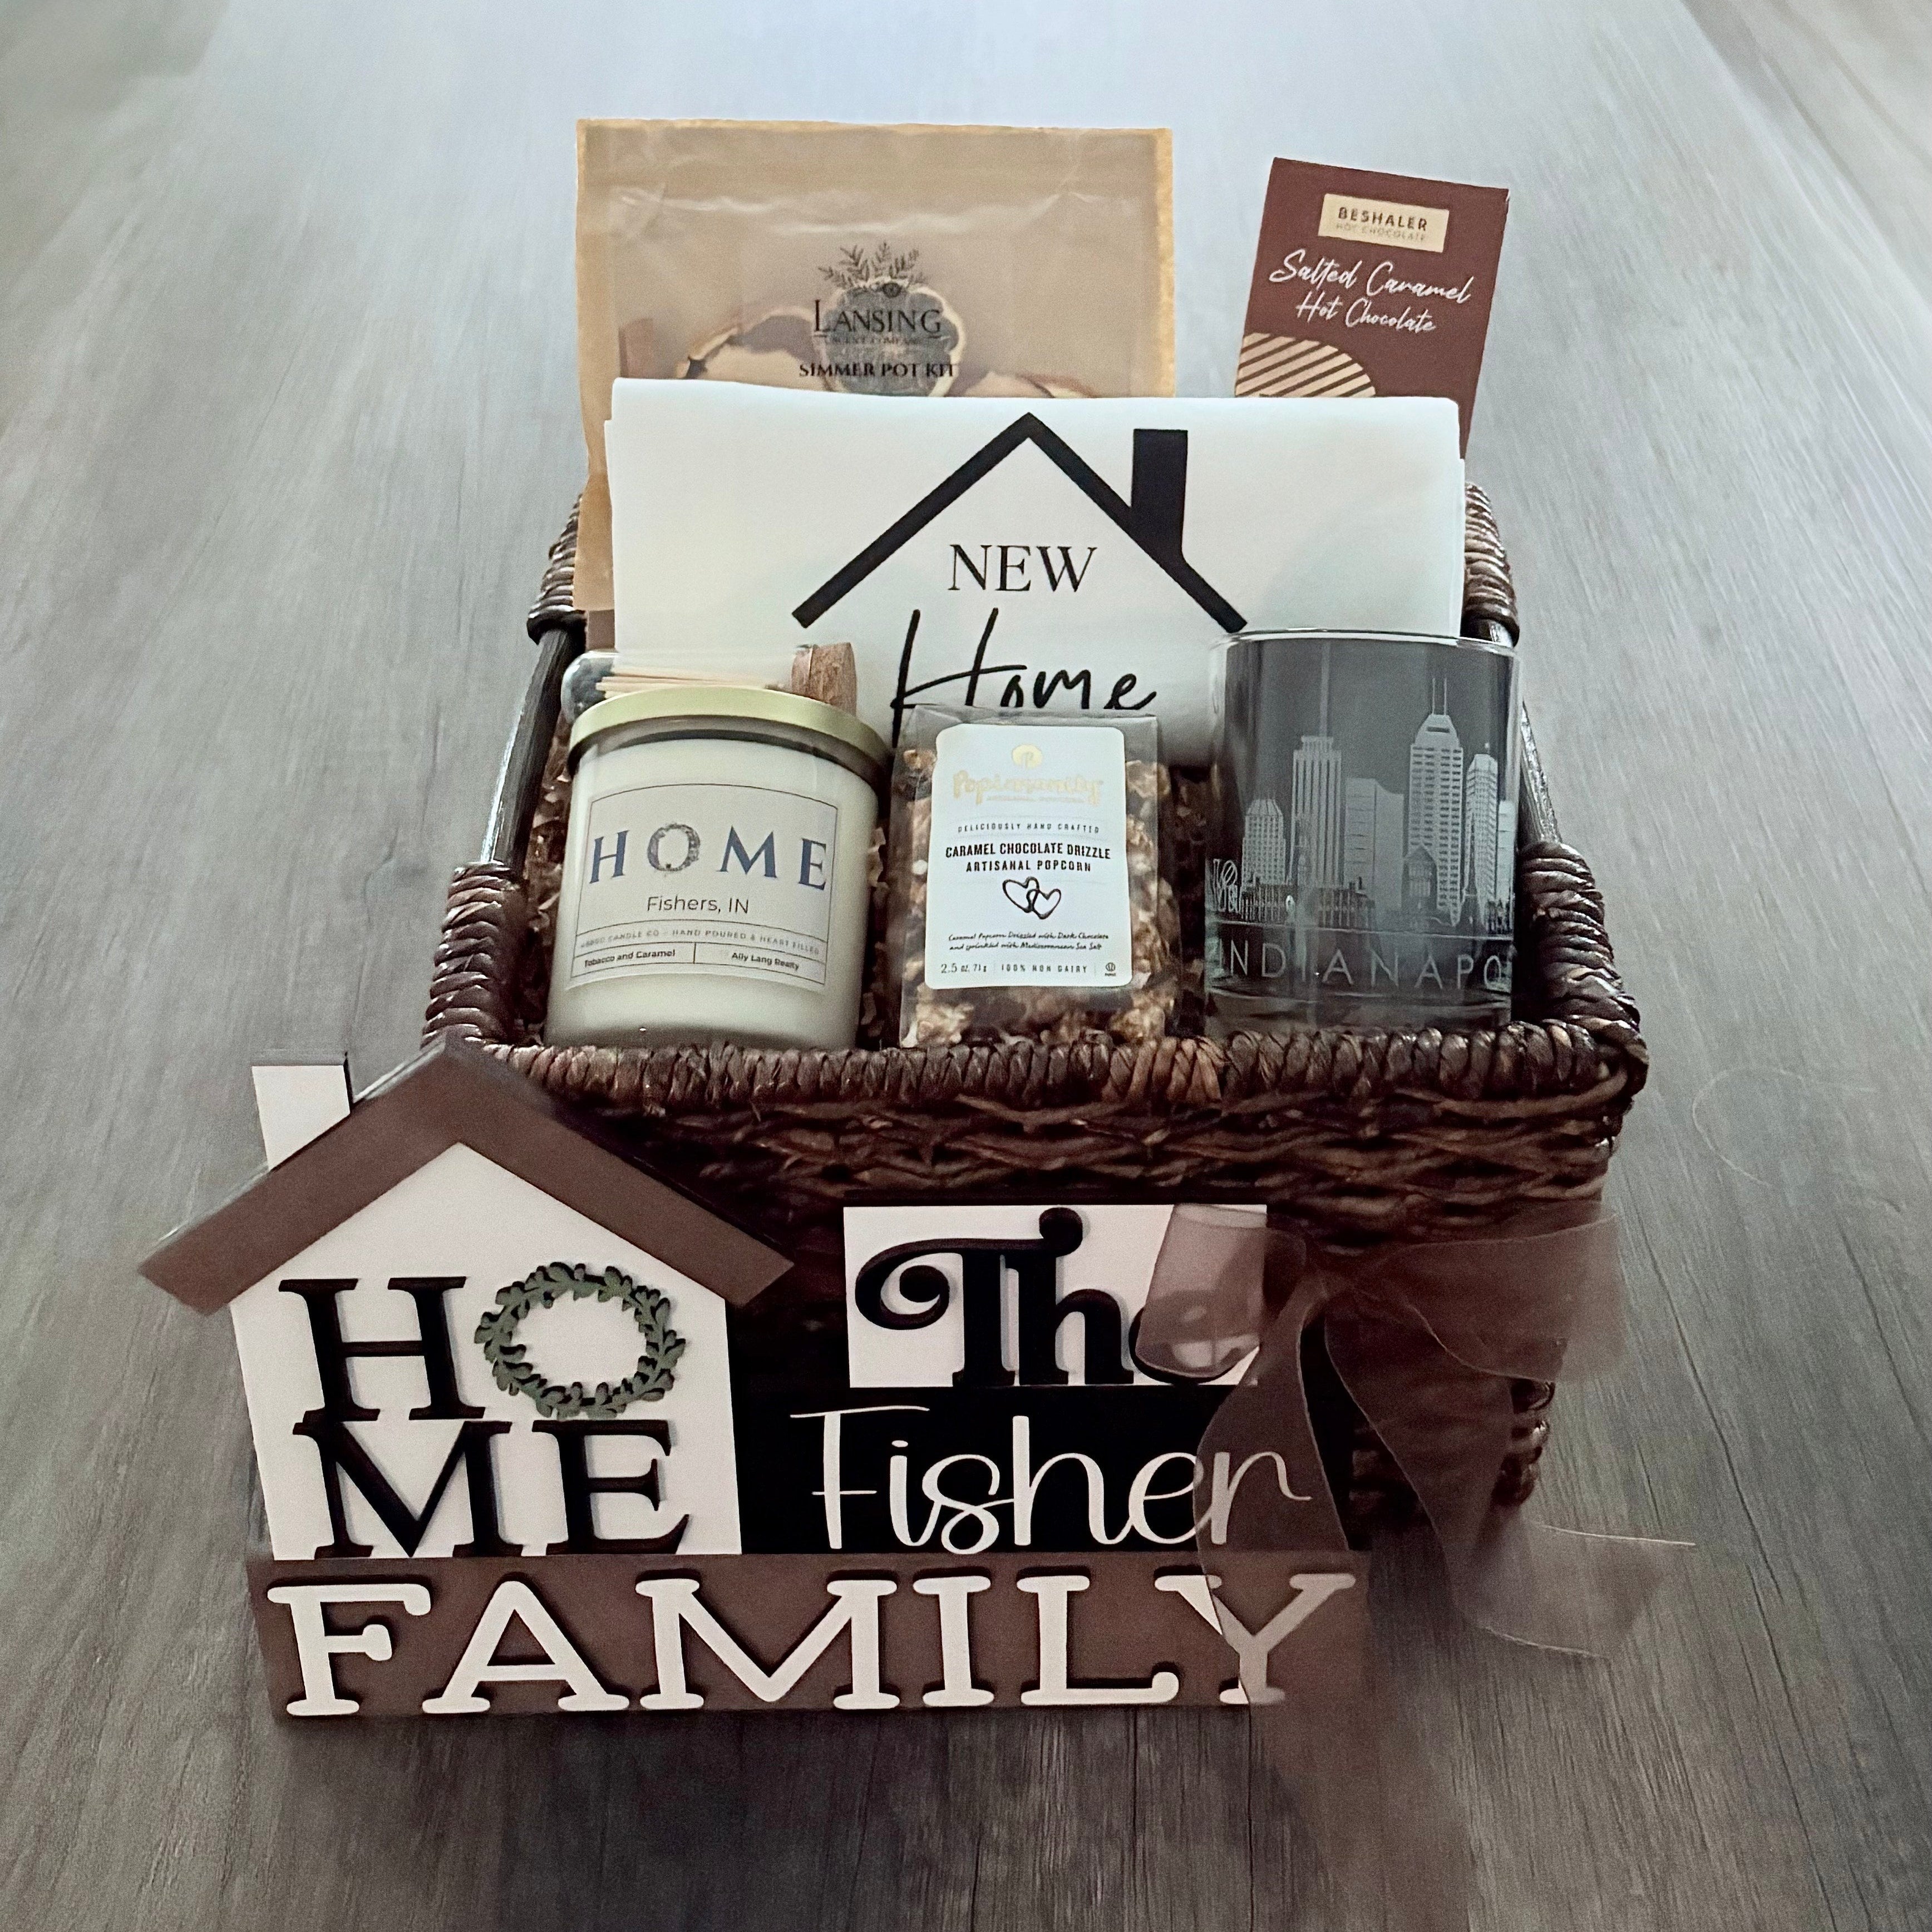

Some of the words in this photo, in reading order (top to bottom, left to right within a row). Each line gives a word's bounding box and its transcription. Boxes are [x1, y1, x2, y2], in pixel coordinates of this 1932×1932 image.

[1338, 206, 1428, 231] BESHALER
[1269, 248, 1363, 290] Salted
[1366, 261, 1475, 304] Caramel
[1295, 290, 1343, 323] Hot
[1344, 297, 1437, 334] Chocolate
[799, 363, 875, 378] SIMMER
[881, 363, 918, 377] POT
[925, 363, 954, 378] KIT
[947, 544, 1098, 593] NEW
[889, 607, 1157, 748] Home
[958, 822, 1021, 833] DELICIOUSLY
[1058, 824, 1100, 834] CRAFTED
[589, 822, 828, 891] HOME
[946, 843, 996, 858] CARAMEL
[1000, 842, 1063, 855] CHOCOLATE
[1067, 844, 1111, 859] DRIZZLE
[965, 860, 1031, 872] ARTISANAL
[1037, 860, 1091, 872] POPCORN
[647, 895, 721, 914] Fishers,
[728, 897, 750, 914] IN
[608, 931, 642, 942] CANDLE
[705, 930, 746, 939] POURED
[760, 935, 790, 947] HEART
[792, 941, 820, 955] FILLED
[584, 955, 615, 968] Tobacco
[617, 951, 634, 961] and
[636, 949, 676, 958] Caramel
[751, 955, 772, 966] Lang
[774, 958, 800, 972] Realty
[941, 963, 958, 974] 2.5
[1001, 963, 1026, 972] 100%
[1058, 965, 1087, 973] DAIRY
[790, 1405, 1312, 1555] Fisher
[267, 1574, 1356, 1717] FAMILY
